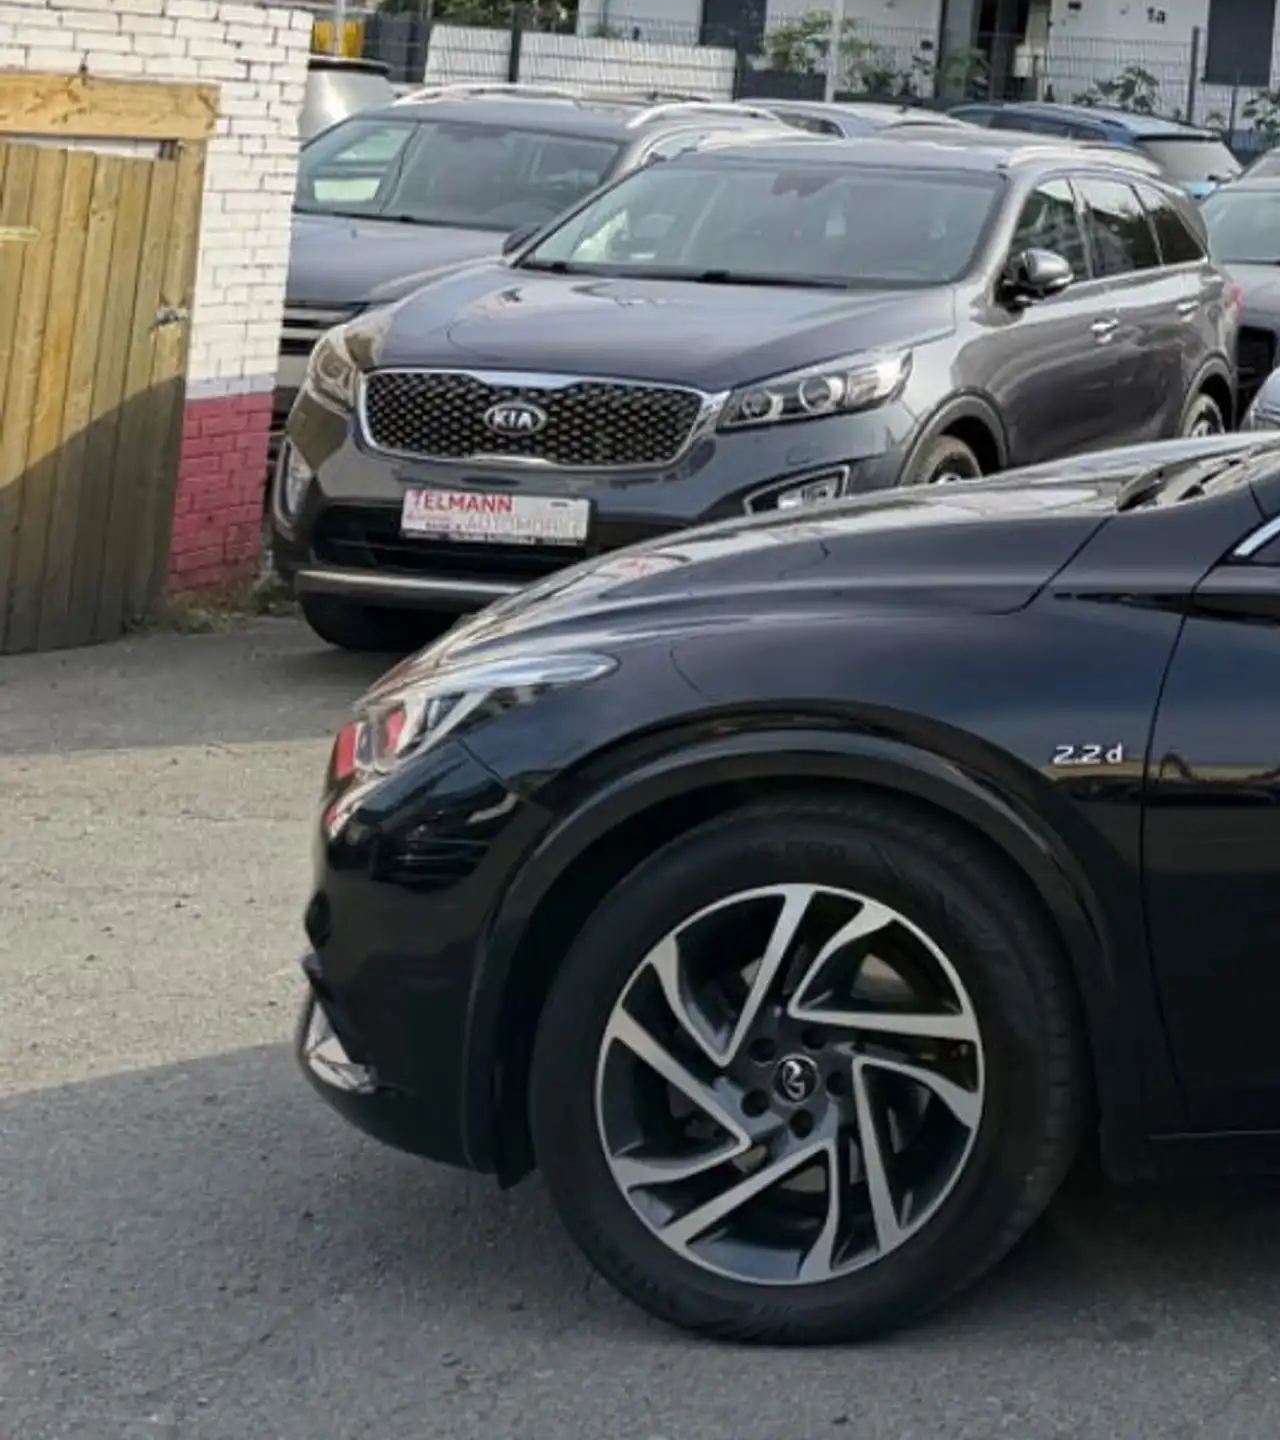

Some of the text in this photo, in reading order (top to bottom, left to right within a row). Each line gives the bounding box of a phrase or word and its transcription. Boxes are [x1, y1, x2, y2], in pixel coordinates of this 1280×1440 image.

[493, 408, 534, 430] KIA
[414, 490, 513, 513] TELMANN
[1052, 741, 1123, 765] 2.2d
